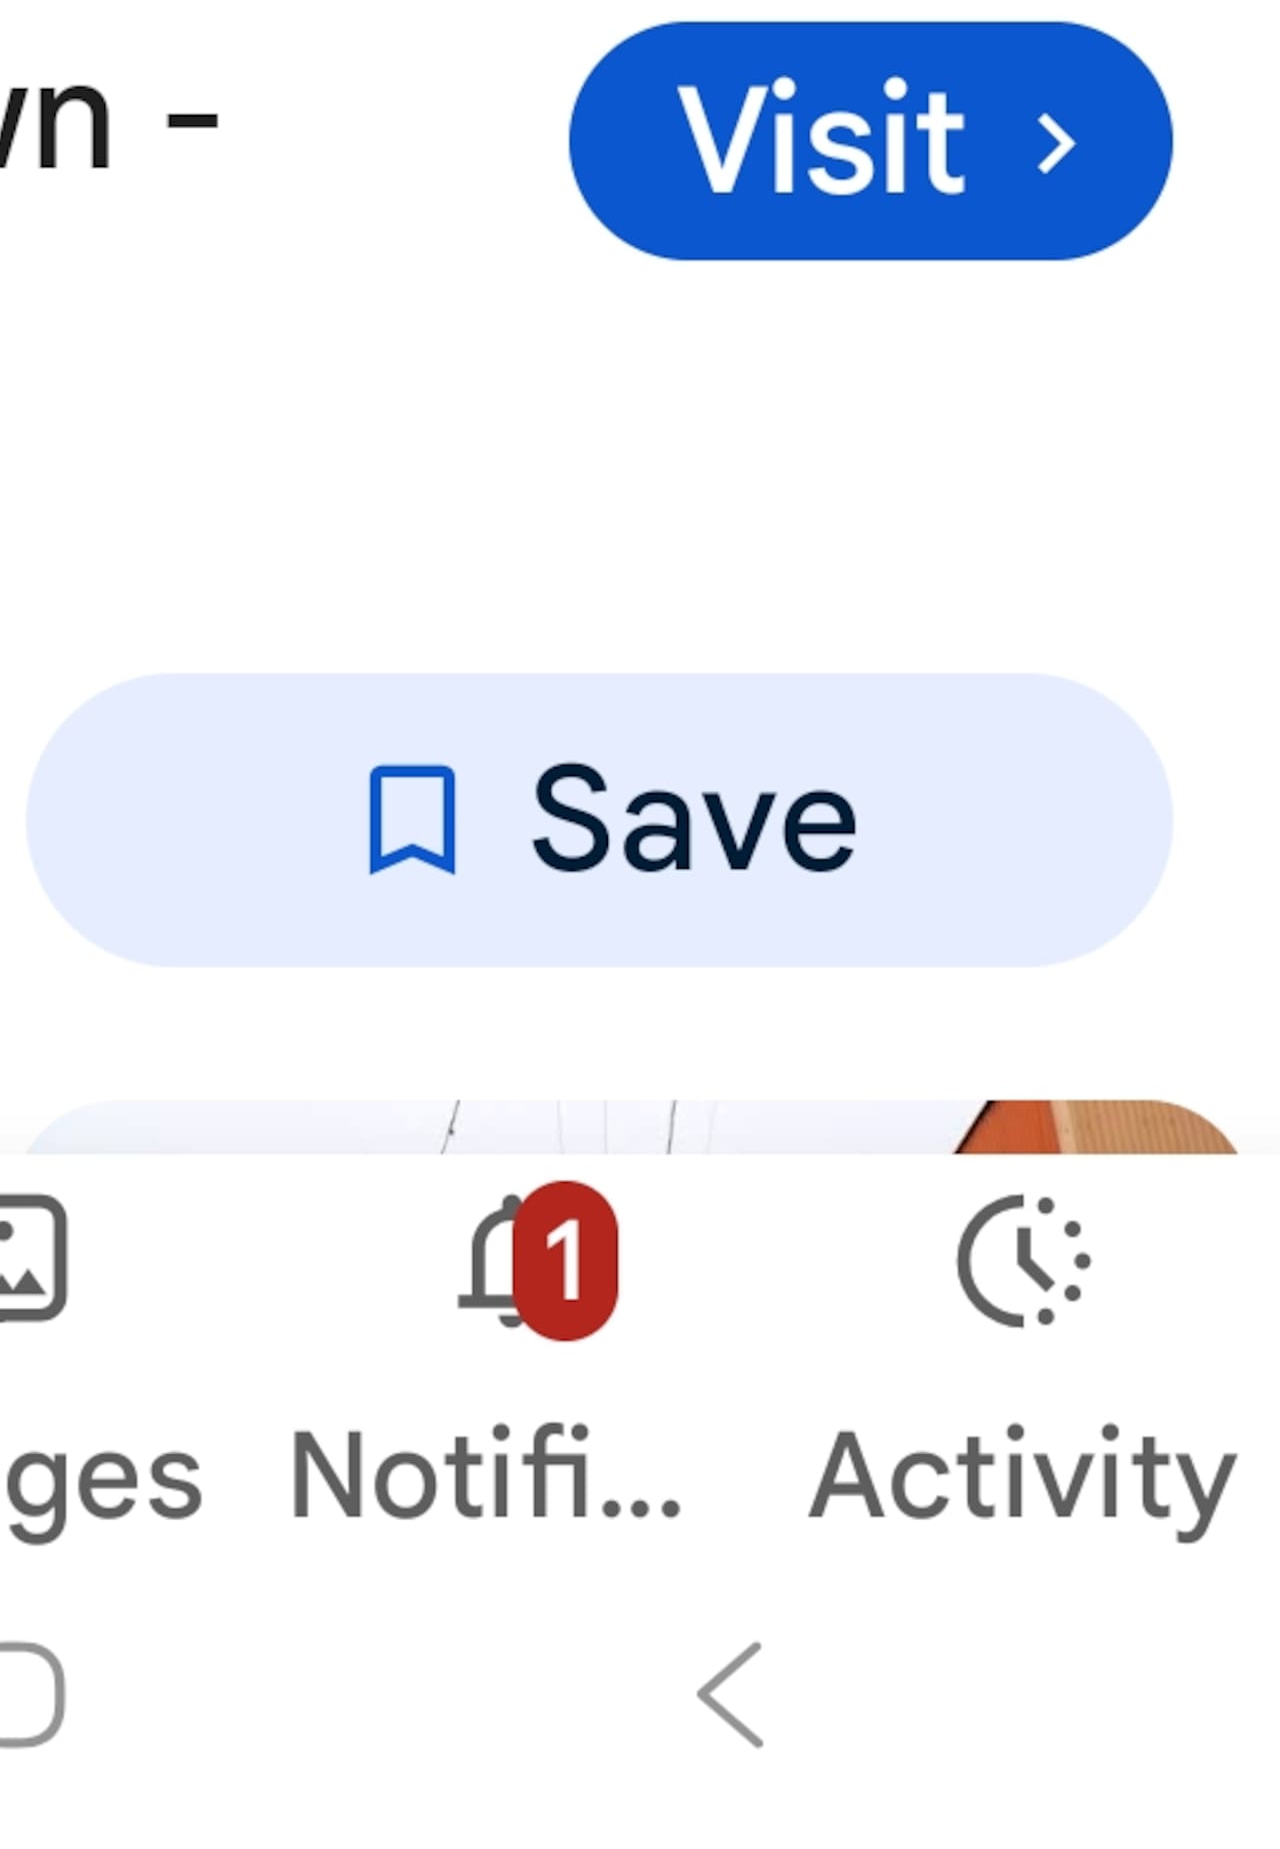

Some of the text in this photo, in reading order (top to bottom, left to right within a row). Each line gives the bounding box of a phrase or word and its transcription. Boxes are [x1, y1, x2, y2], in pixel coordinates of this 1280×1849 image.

[167, 113, 218, 128] -
[677, 77, 965, 195] Visit
[532, 762, 856, 873] Save
[547, 1219, 581, 1300] 1
[294, 1422, 682, 1522] Notifi...
[808, 1423, 1237, 1544] Activity
